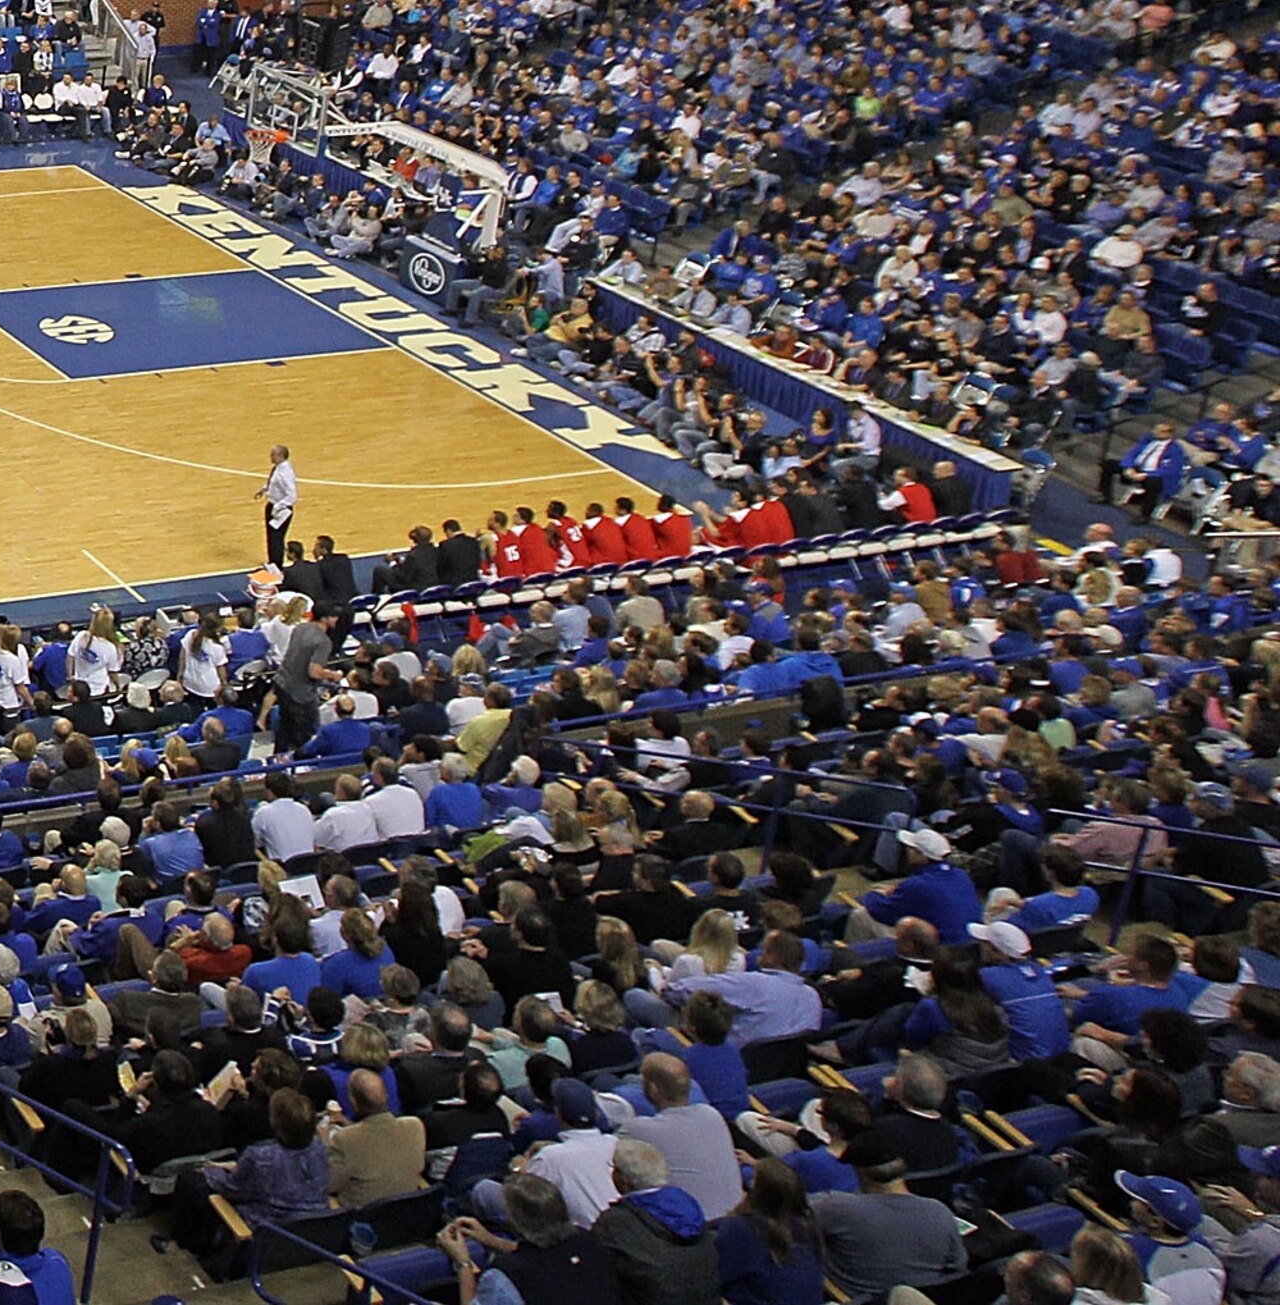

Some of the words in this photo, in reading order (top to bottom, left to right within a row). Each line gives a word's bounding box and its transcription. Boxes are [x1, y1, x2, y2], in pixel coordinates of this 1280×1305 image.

[39, 314, 115, 345] SEC
[122, 184, 683, 461] KENTUCKY
[504, 545, 521, 562] 15
